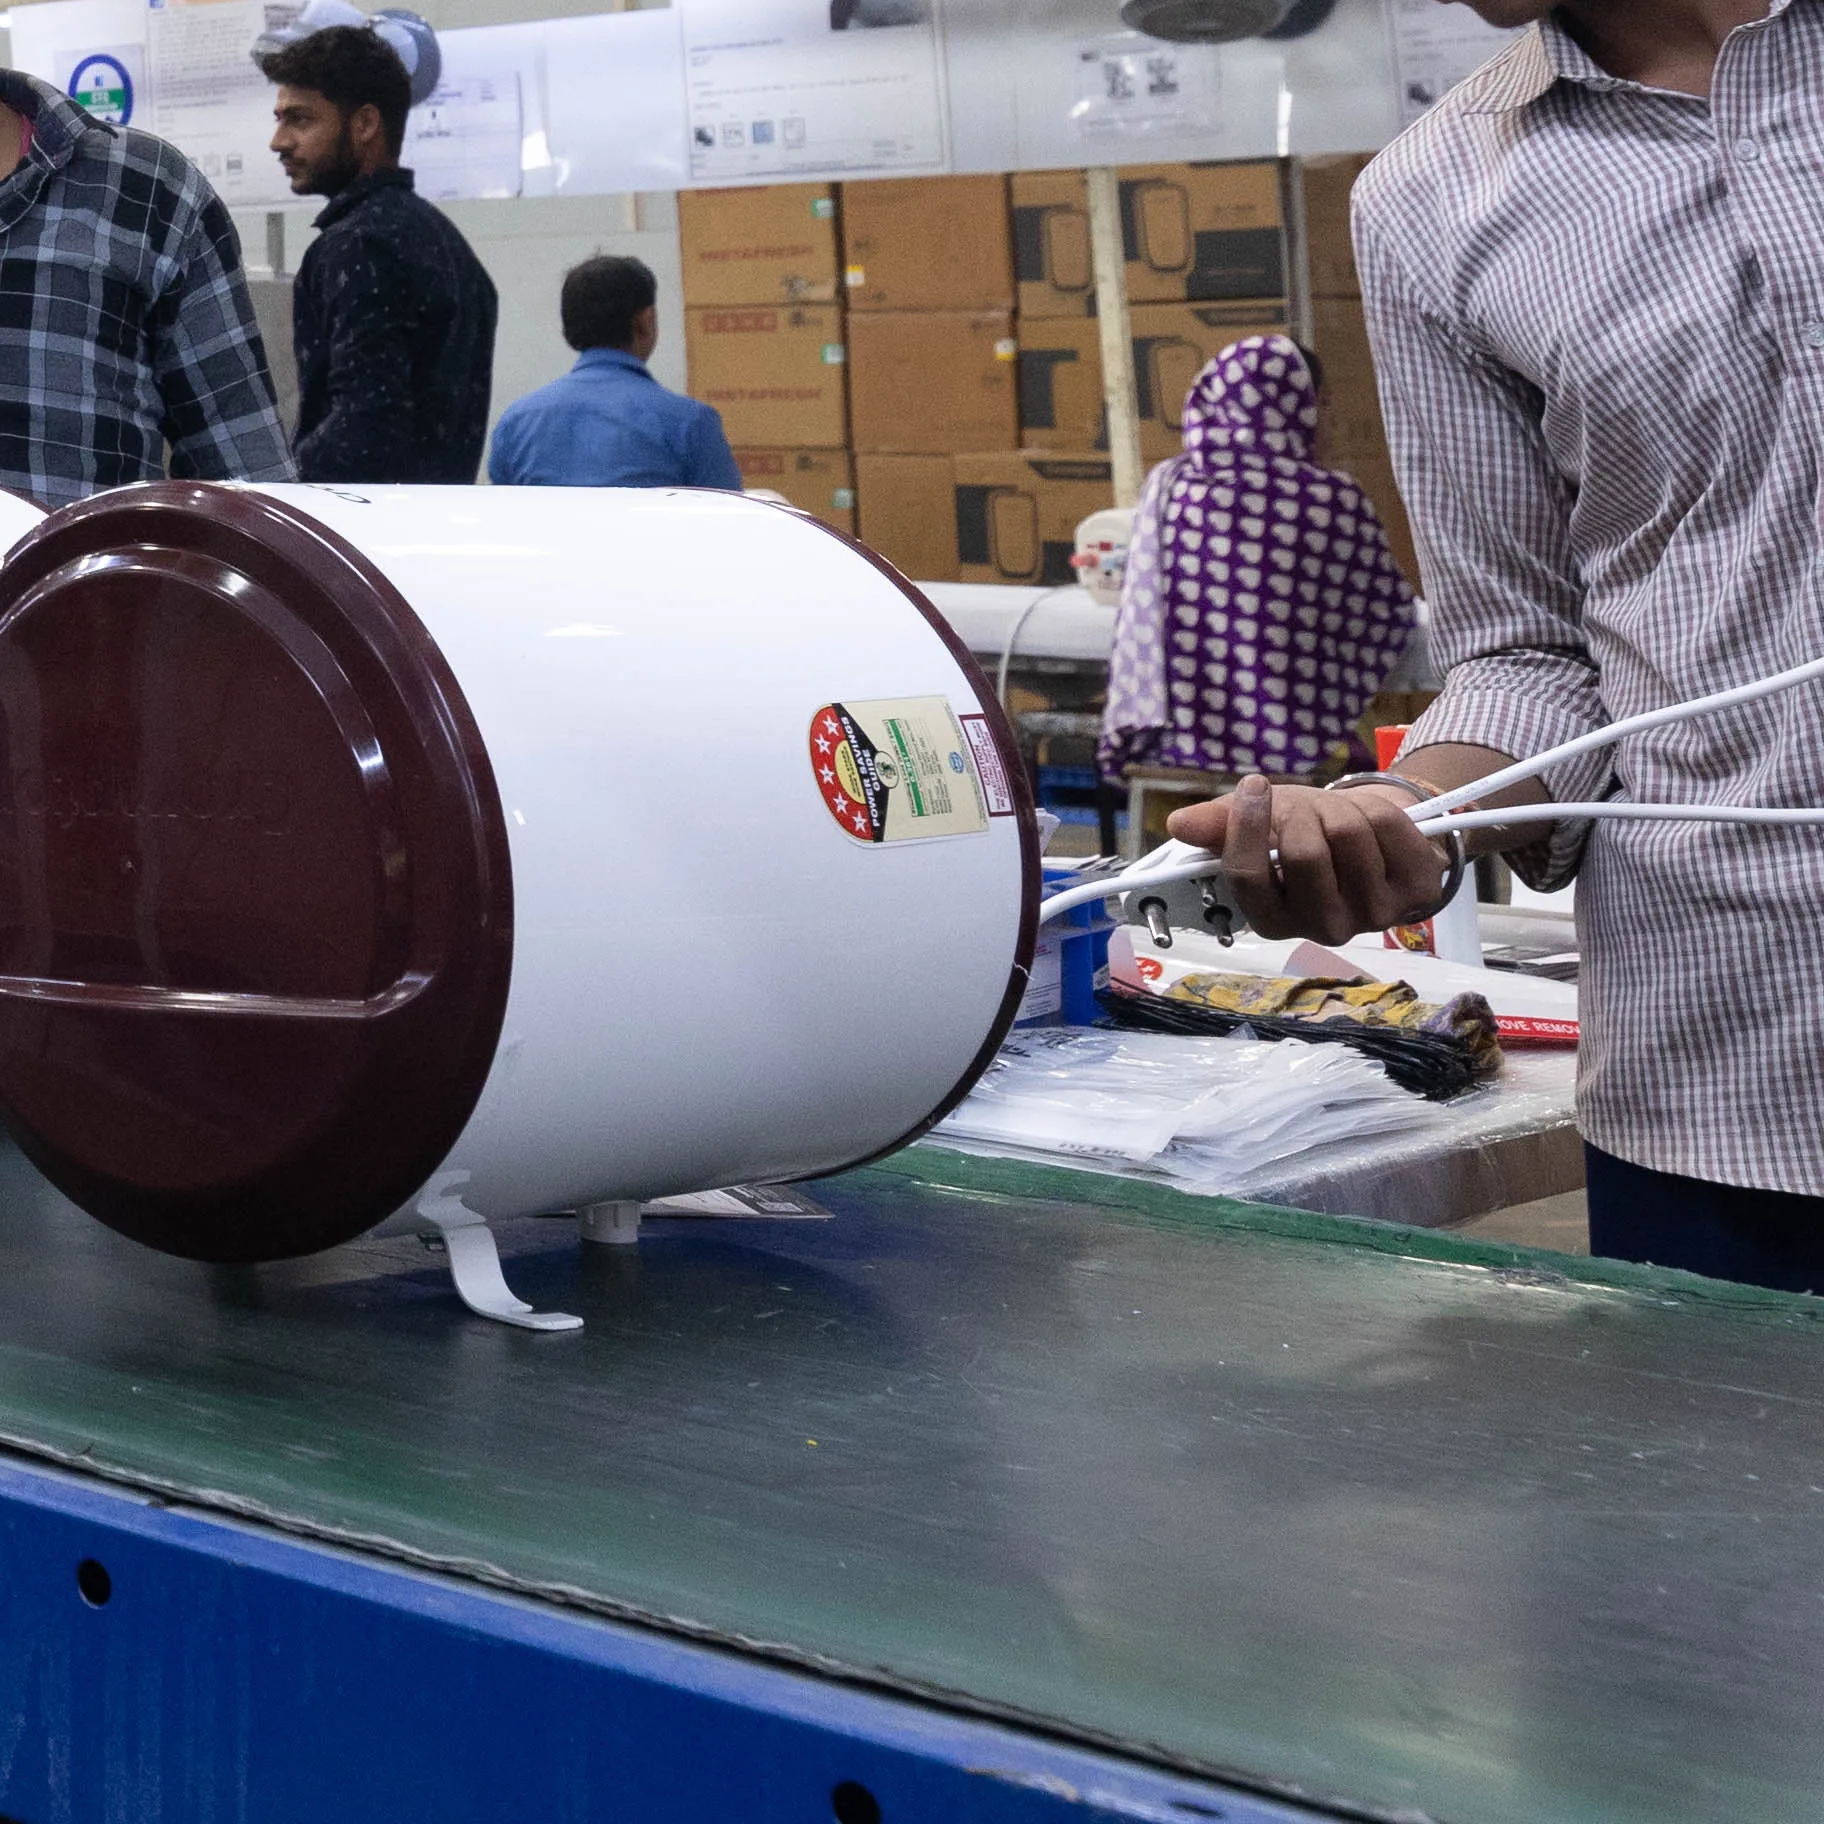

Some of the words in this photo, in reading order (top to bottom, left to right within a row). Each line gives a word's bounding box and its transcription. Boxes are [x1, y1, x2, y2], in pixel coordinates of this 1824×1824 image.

[841, 716, 868, 775] SAVINGS
[862, 749, 881, 792] GUIDE
[863, 778, 881, 827] POWER
[1532, 1021, 1581, 1034] REMOV
